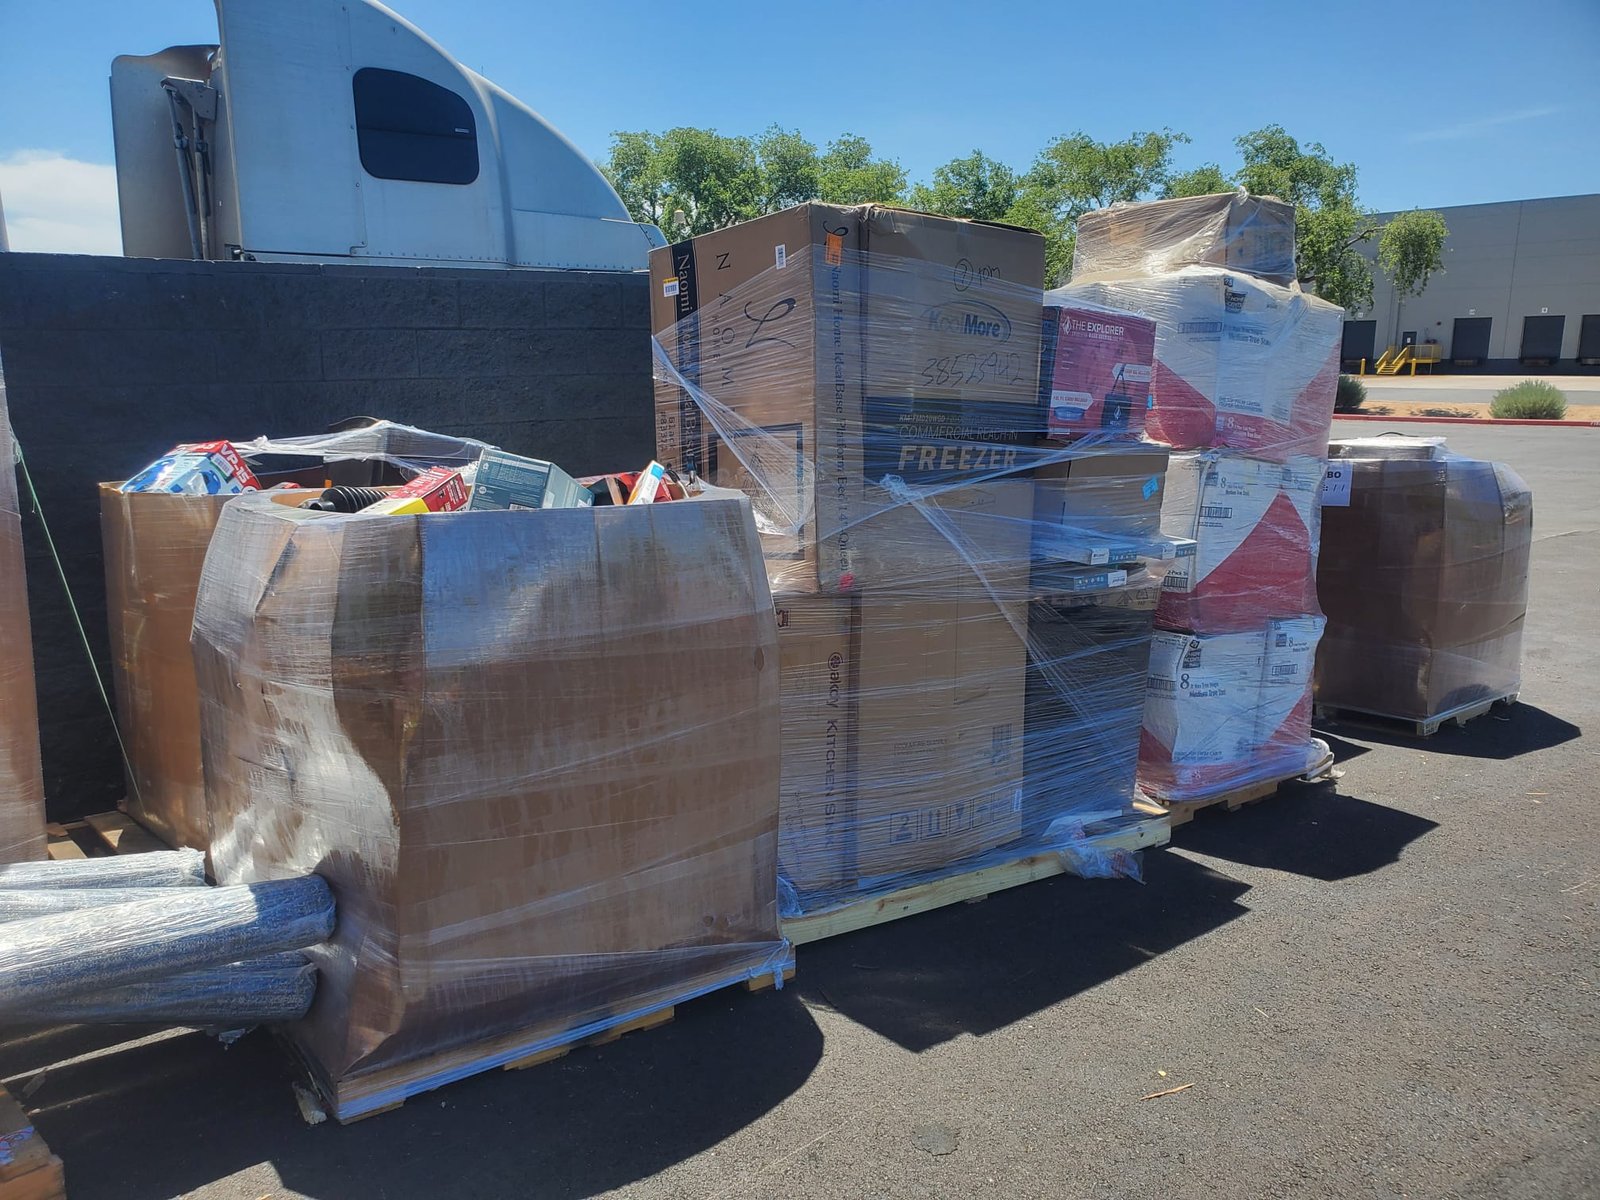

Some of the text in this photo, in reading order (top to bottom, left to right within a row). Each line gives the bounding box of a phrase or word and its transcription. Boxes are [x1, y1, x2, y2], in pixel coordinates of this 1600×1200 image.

[678, 253, 693, 312] Naomi
[832, 309, 843, 346] Home
[1072, 320, 1124, 336] THE EXPLORER
[899, 425, 974, 440] COMMERCIAL
[898, 445, 1017, 471] FREEZER
[826, 719, 839, 797] KITCHEN
